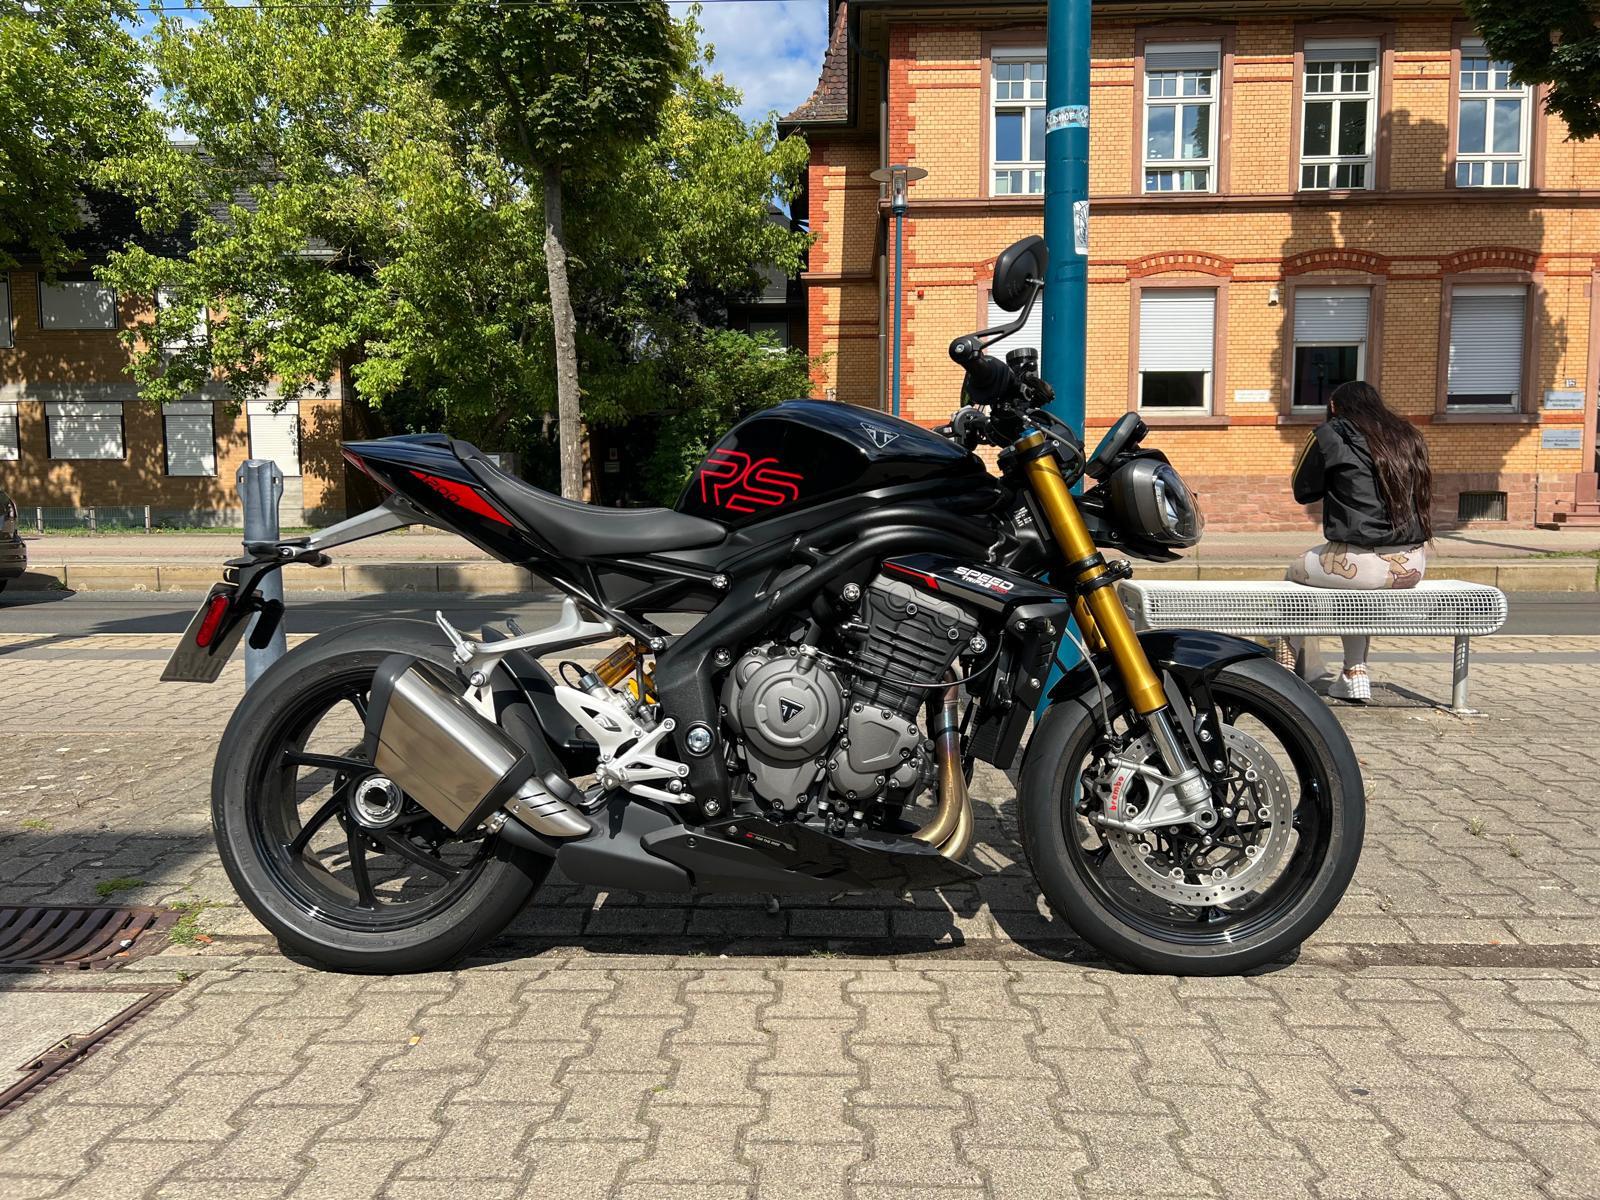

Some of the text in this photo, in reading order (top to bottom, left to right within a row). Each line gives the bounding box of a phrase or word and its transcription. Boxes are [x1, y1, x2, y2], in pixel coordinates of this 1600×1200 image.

[700, 447, 804, 513] RS
[953, 566, 1015, 591] SPEED
[961, 575, 992, 589] TRIPLE
[1108, 775, 1124, 811] brembo
